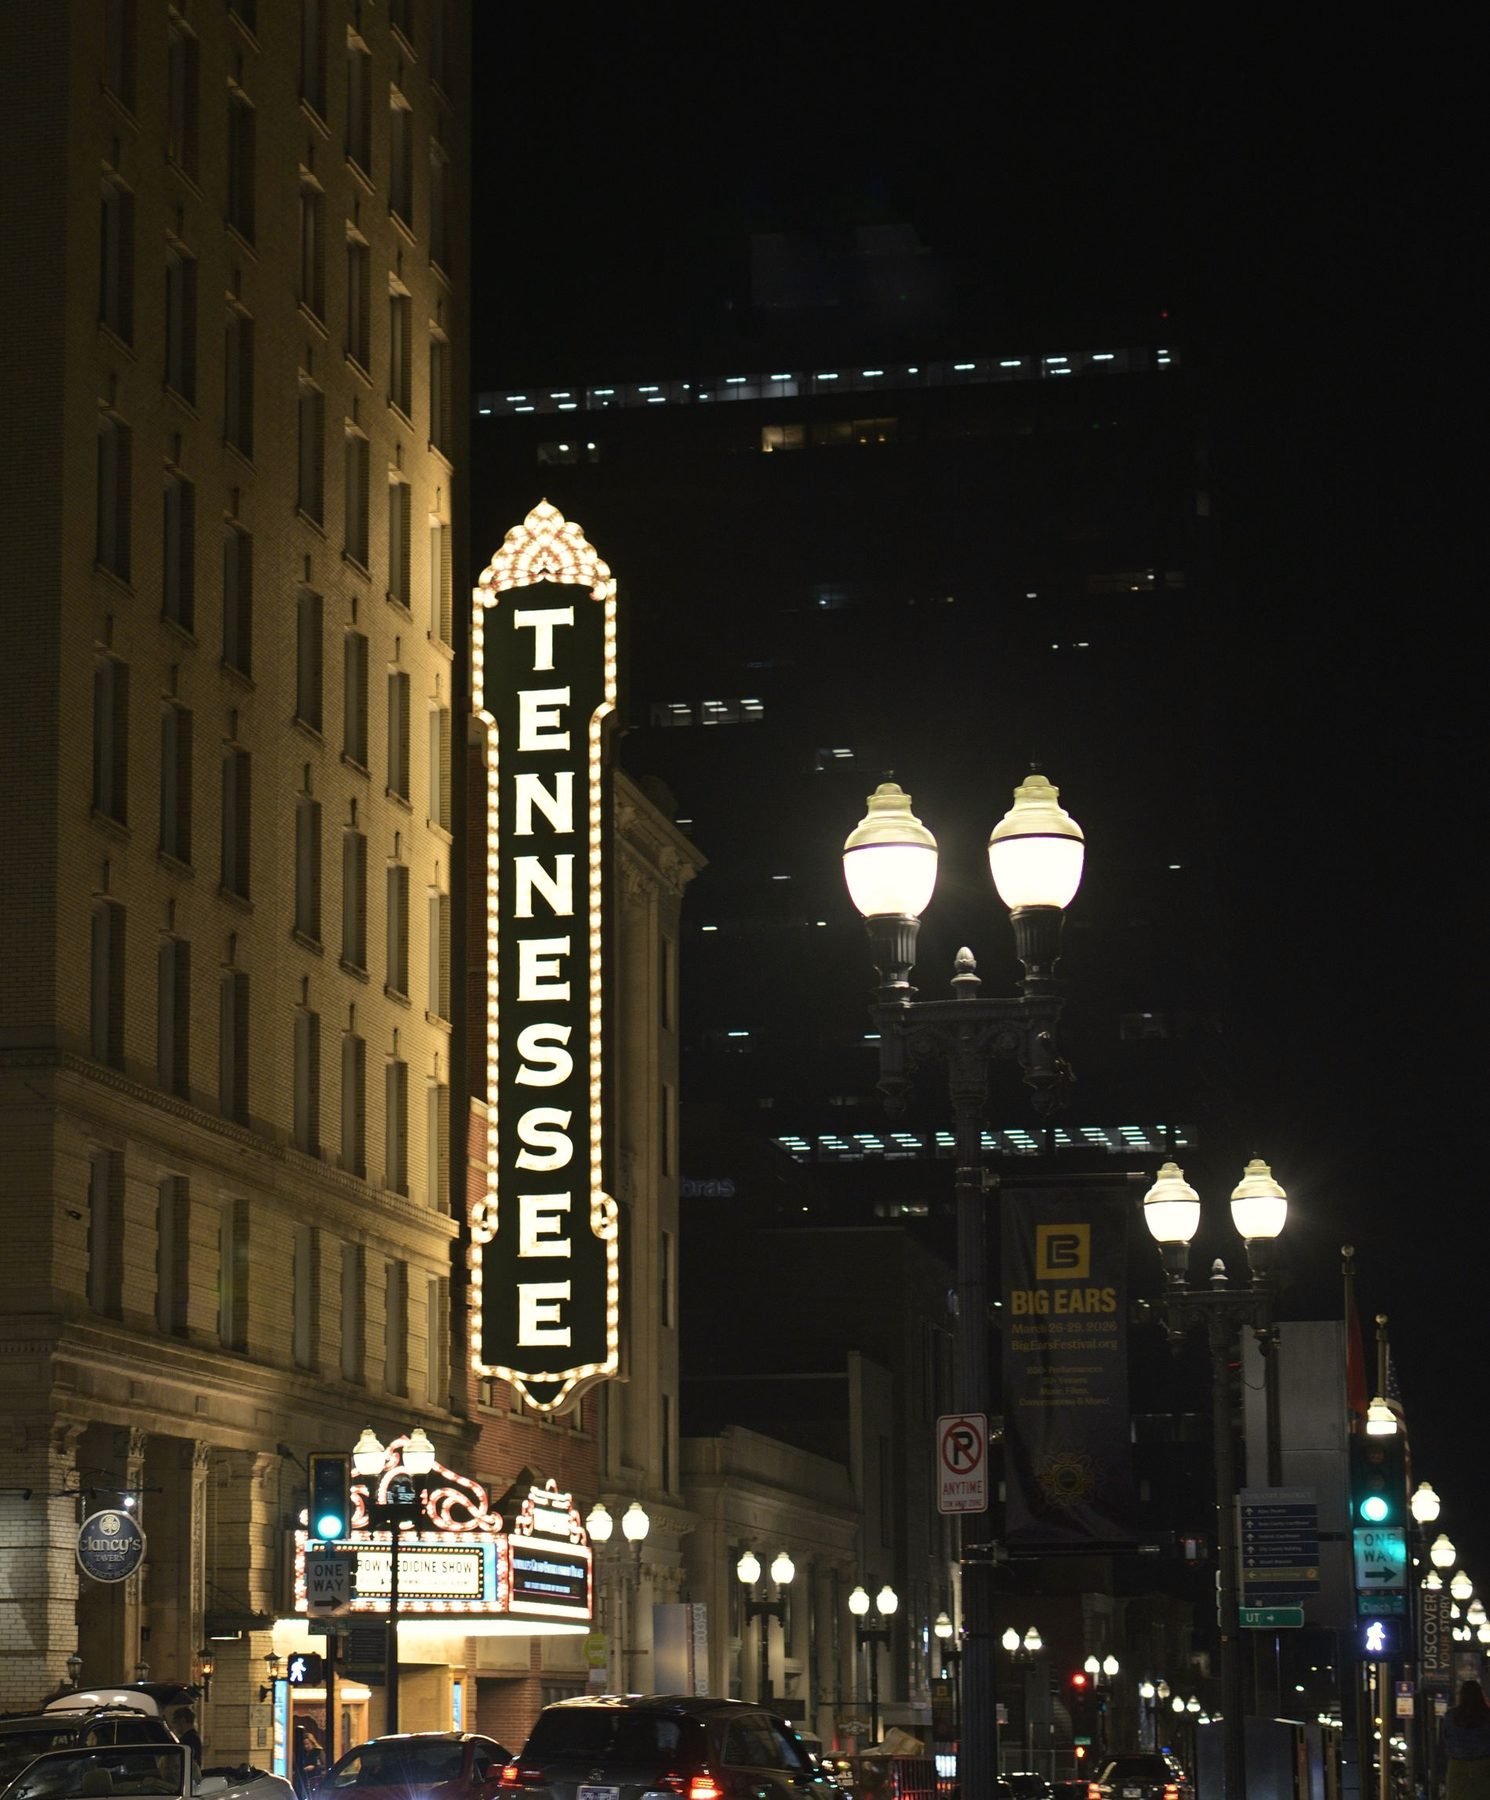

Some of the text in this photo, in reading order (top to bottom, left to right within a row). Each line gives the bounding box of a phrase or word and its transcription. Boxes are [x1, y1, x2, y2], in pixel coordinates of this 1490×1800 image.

[513, 605, 576, 1348] TENNESSEE
[1011, 1287, 1118, 1315] BIG EARS
[1086, 1320, 1118, 1332] 2026
[943, 1480, 983, 1495] ANYTIME
[80, 1536, 142, 1555] clancy's
[1364, 1533, 1396, 1546] ONE
[94, 1554, 126, 1562] TAVERN
[314, 1564, 342, 1577] ONE
[357, 1559, 381, 1571] ROW
[441, 1561, 472, 1573] SHOW
[313, 1579, 344, 1592] WAY
[1246, 1613, 1261, 1623] UT
[1424, 1594, 1438, 1669] DISCOVER
[1440, 1595, 1451, 1669] YOUR STORY
